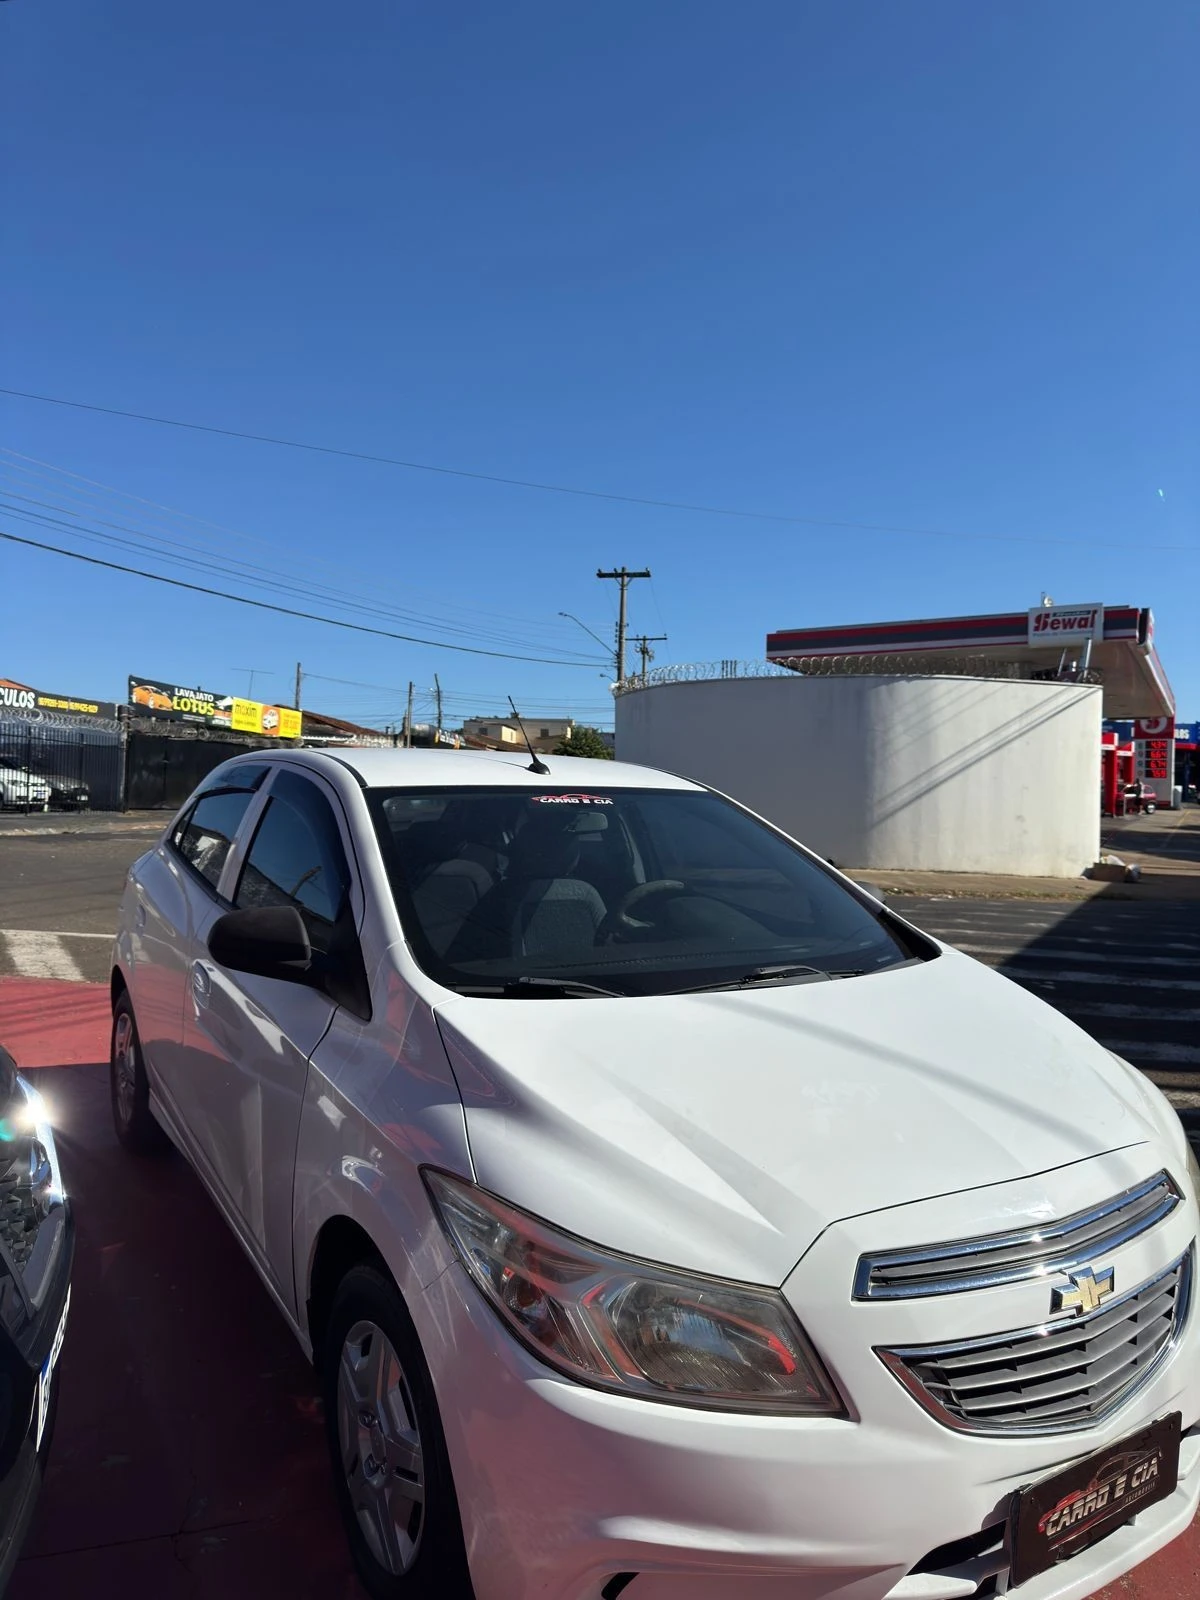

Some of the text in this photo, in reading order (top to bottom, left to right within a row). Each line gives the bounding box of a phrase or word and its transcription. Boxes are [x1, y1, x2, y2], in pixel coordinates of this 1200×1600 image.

[1033, 610, 1097, 632] Sewal
[172, 696, 215, 716] LOTUS
[1046, 1484, 1110, 1537] CARRO
[1114, 1474, 1128, 1499] E
[1131, 1457, 1159, 1488] CIA
